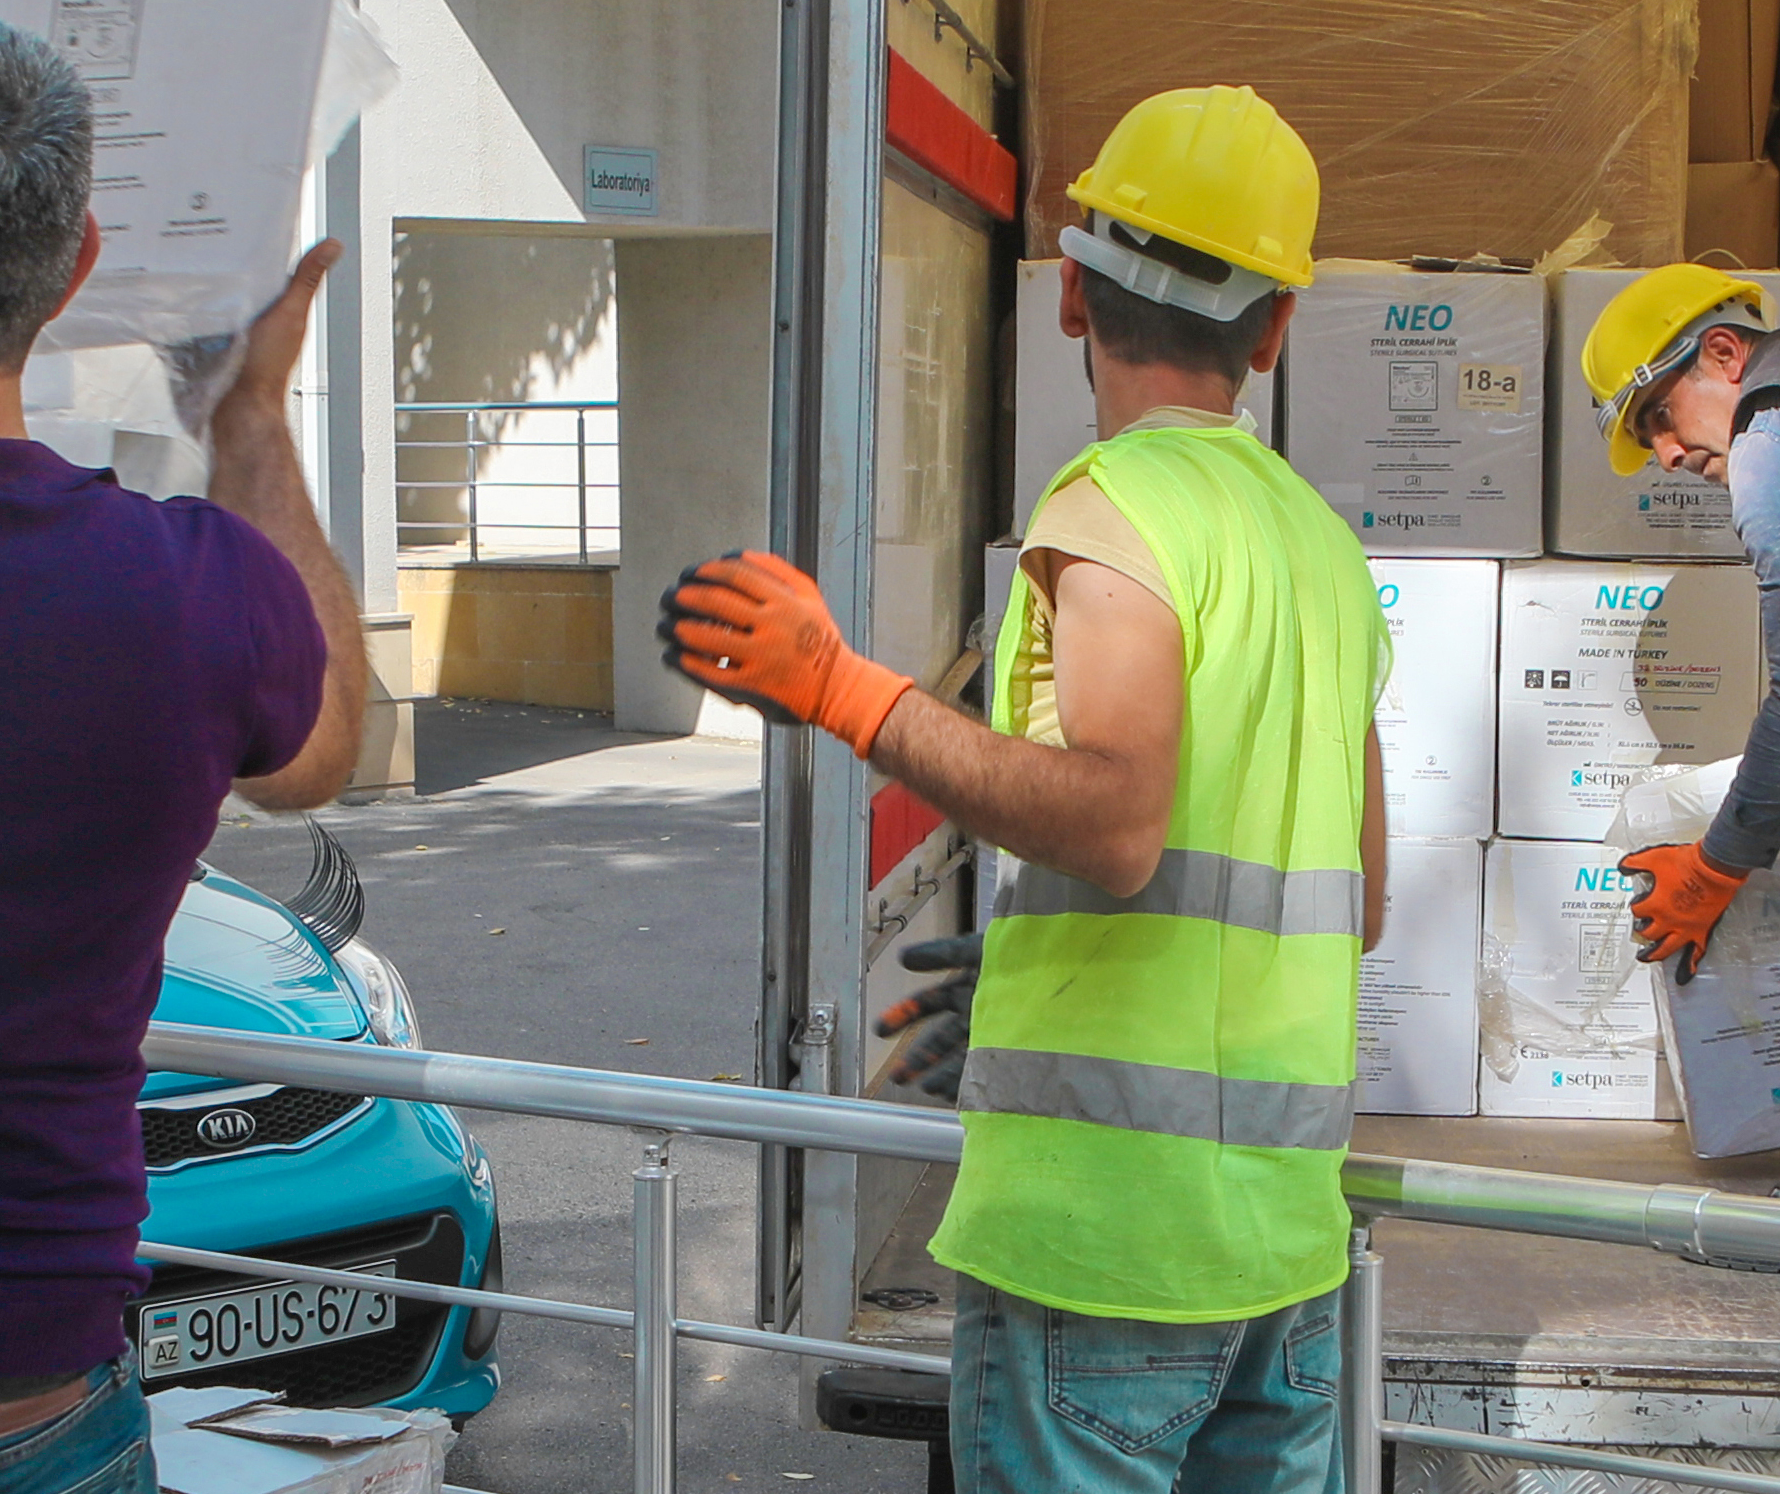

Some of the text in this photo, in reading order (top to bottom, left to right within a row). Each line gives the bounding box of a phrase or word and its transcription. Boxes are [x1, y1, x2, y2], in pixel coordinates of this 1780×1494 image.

[591, 168, 650, 197] Laboratoriya
[1384, 304, 1454, 332] NEO
[1463, 369, 1516, 393] 18-a
[1653, 490, 1700, 510] setpa
[1378, 511, 1425, 531] setpa
[1595, 585, 1665, 610] NEO
[1578, 649, 1669, 660] MADE IN TURKEY
[1634, 677, 1648, 688] 50
[1584, 769, 1631, 791] setpa
[1566, 1070, 1613, 1090] setpa
[208, 1114, 249, 1141] KIA
[188, 1273, 393, 1362] 90-US-673
[154, 1343, 179, 1363] AZ
